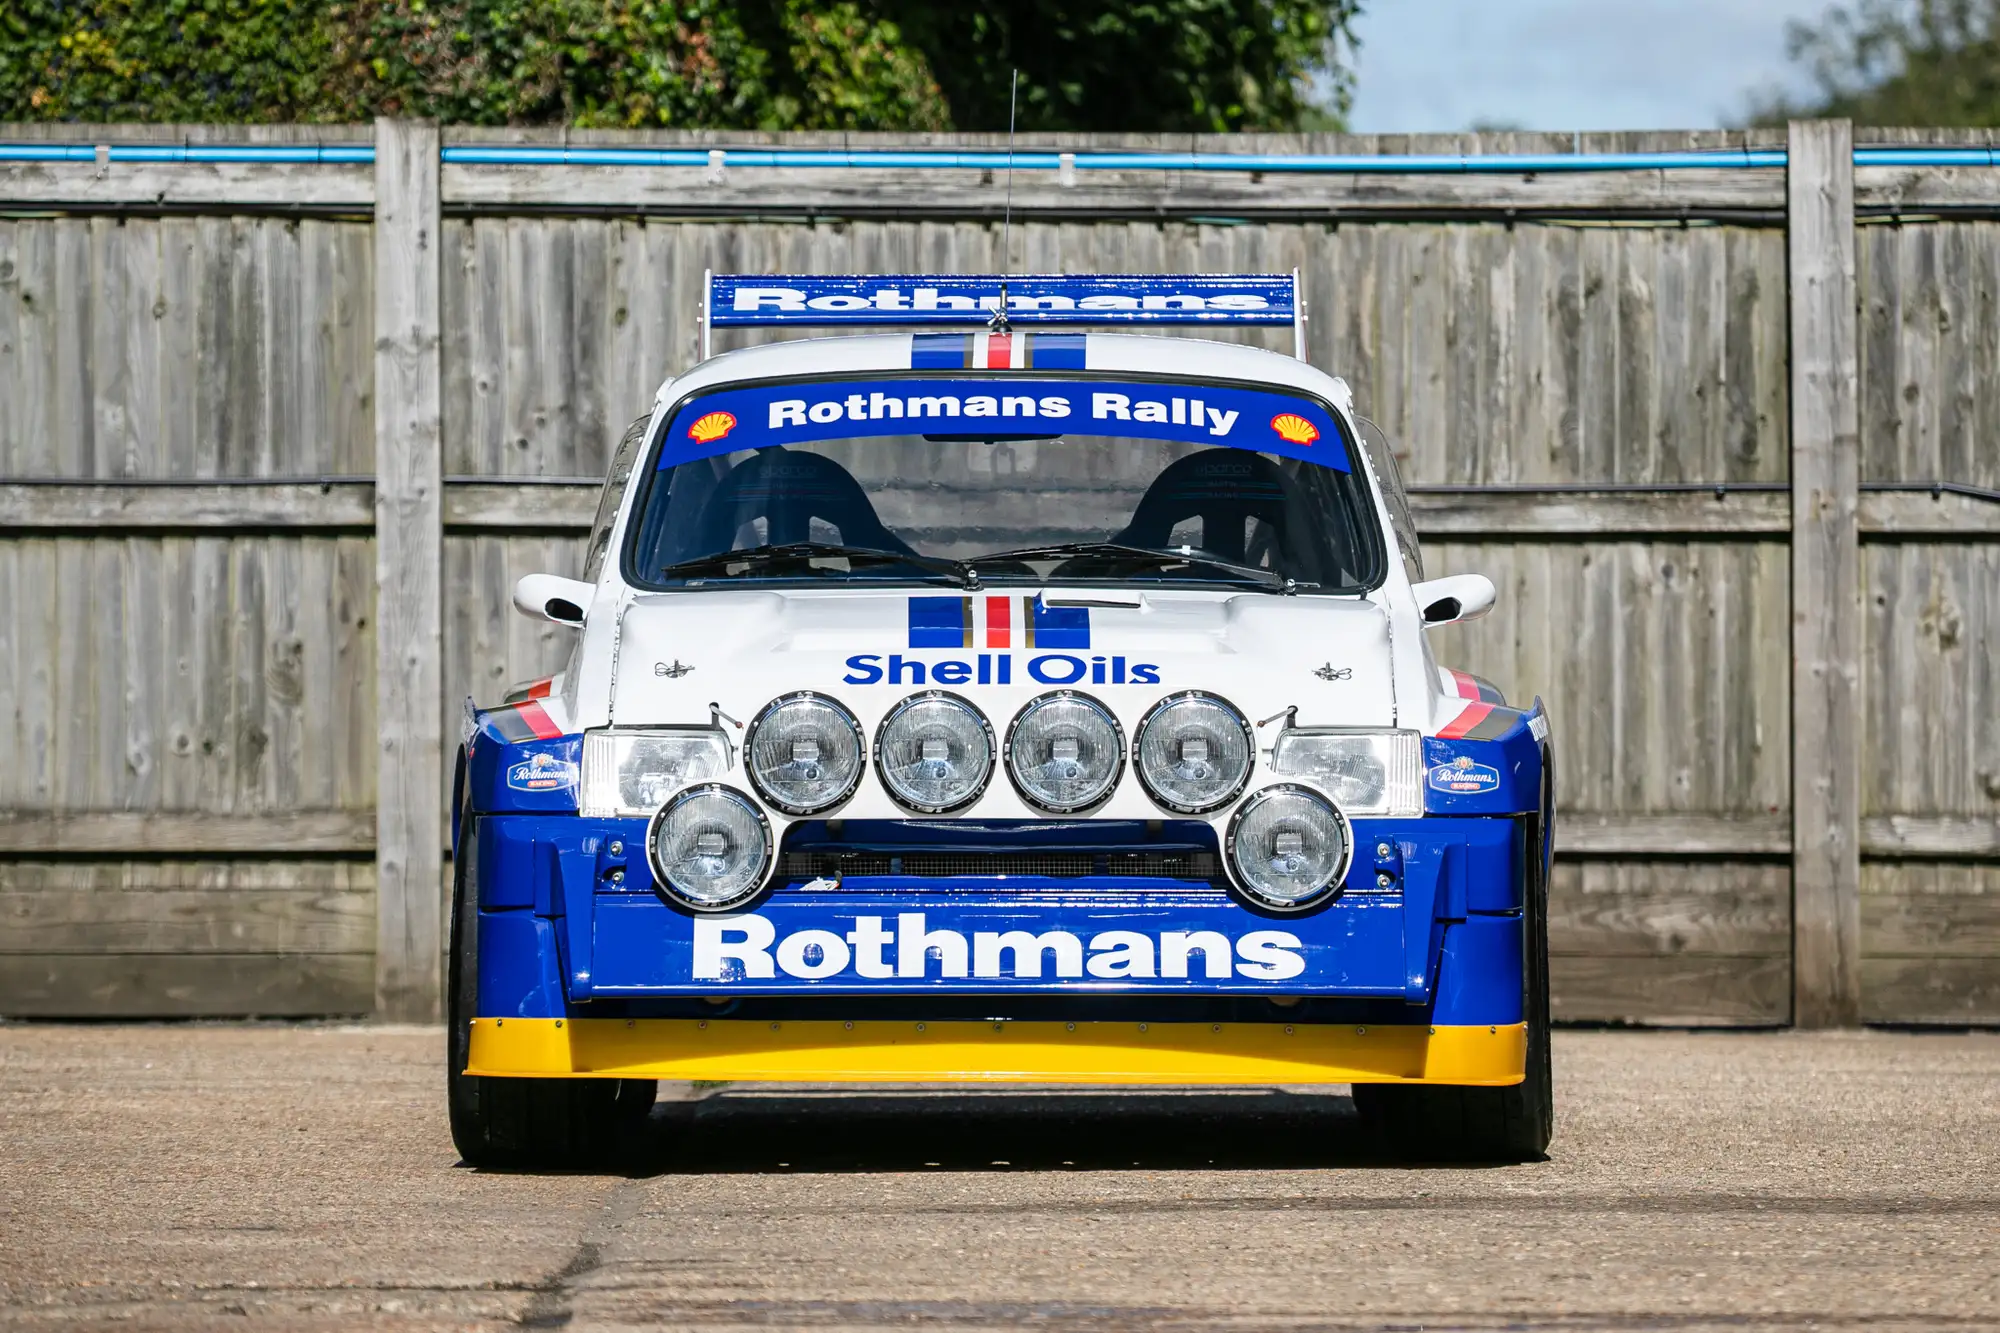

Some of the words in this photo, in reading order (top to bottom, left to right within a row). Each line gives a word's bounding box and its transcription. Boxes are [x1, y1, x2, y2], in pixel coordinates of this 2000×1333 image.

[733, 287, 1269, 312] Rothmans
[768, 392, 1072, 429] Rothmans
[1091, 392, 1240, 436] Rally
[842, 654, 1012, 685] Shell
[1027, 654, 1161, 685] Oils
[513, 766, 569, 781] Rothmans
[1436, 768, 1495, 783] Rothmans
[692, 912, 1306, 981] Rothmans
